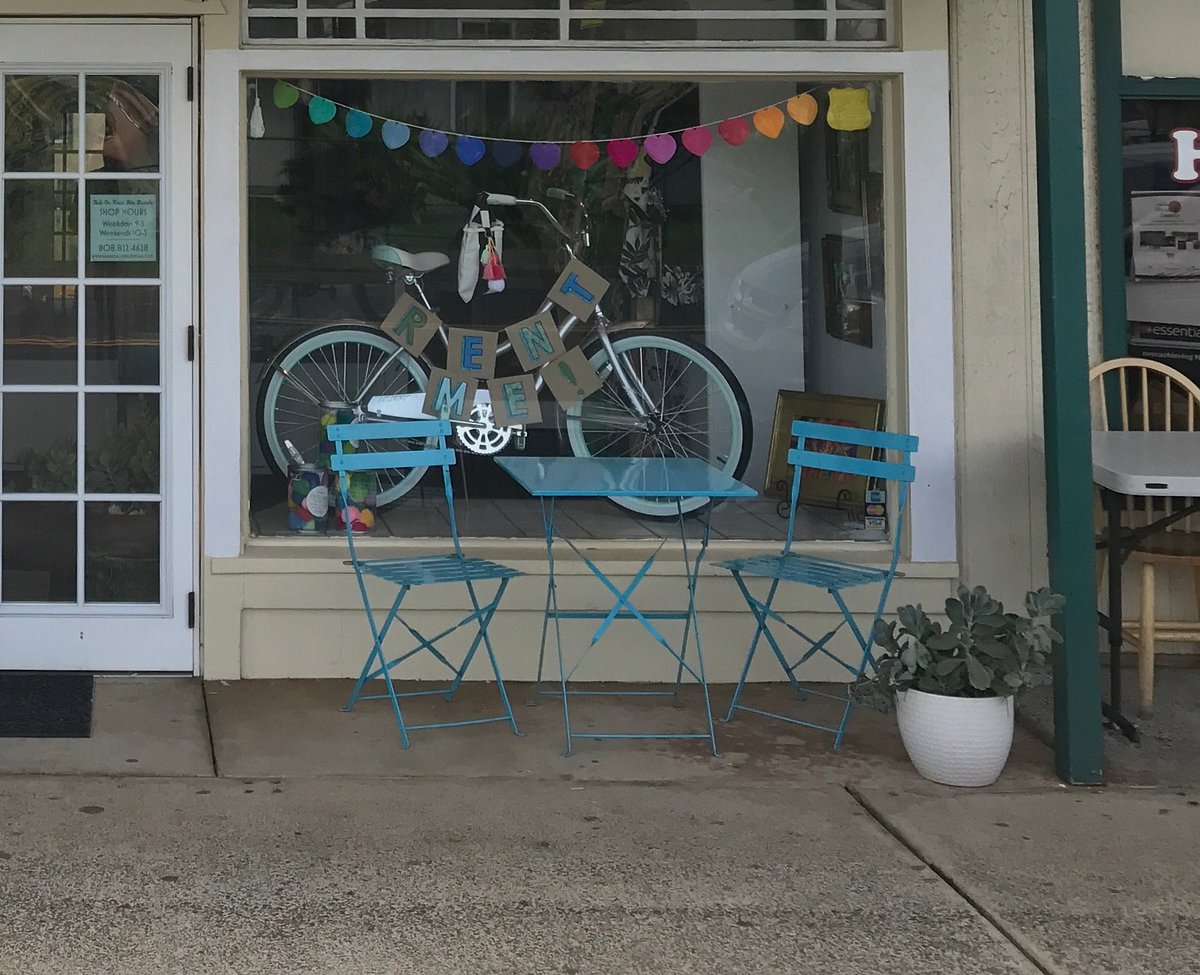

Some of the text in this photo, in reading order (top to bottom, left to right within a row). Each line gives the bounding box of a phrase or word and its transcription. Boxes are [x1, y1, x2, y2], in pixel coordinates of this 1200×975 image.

[99, 208, 147, 216] SHOP HOURS
[392, 272, 596, 371] RENT
